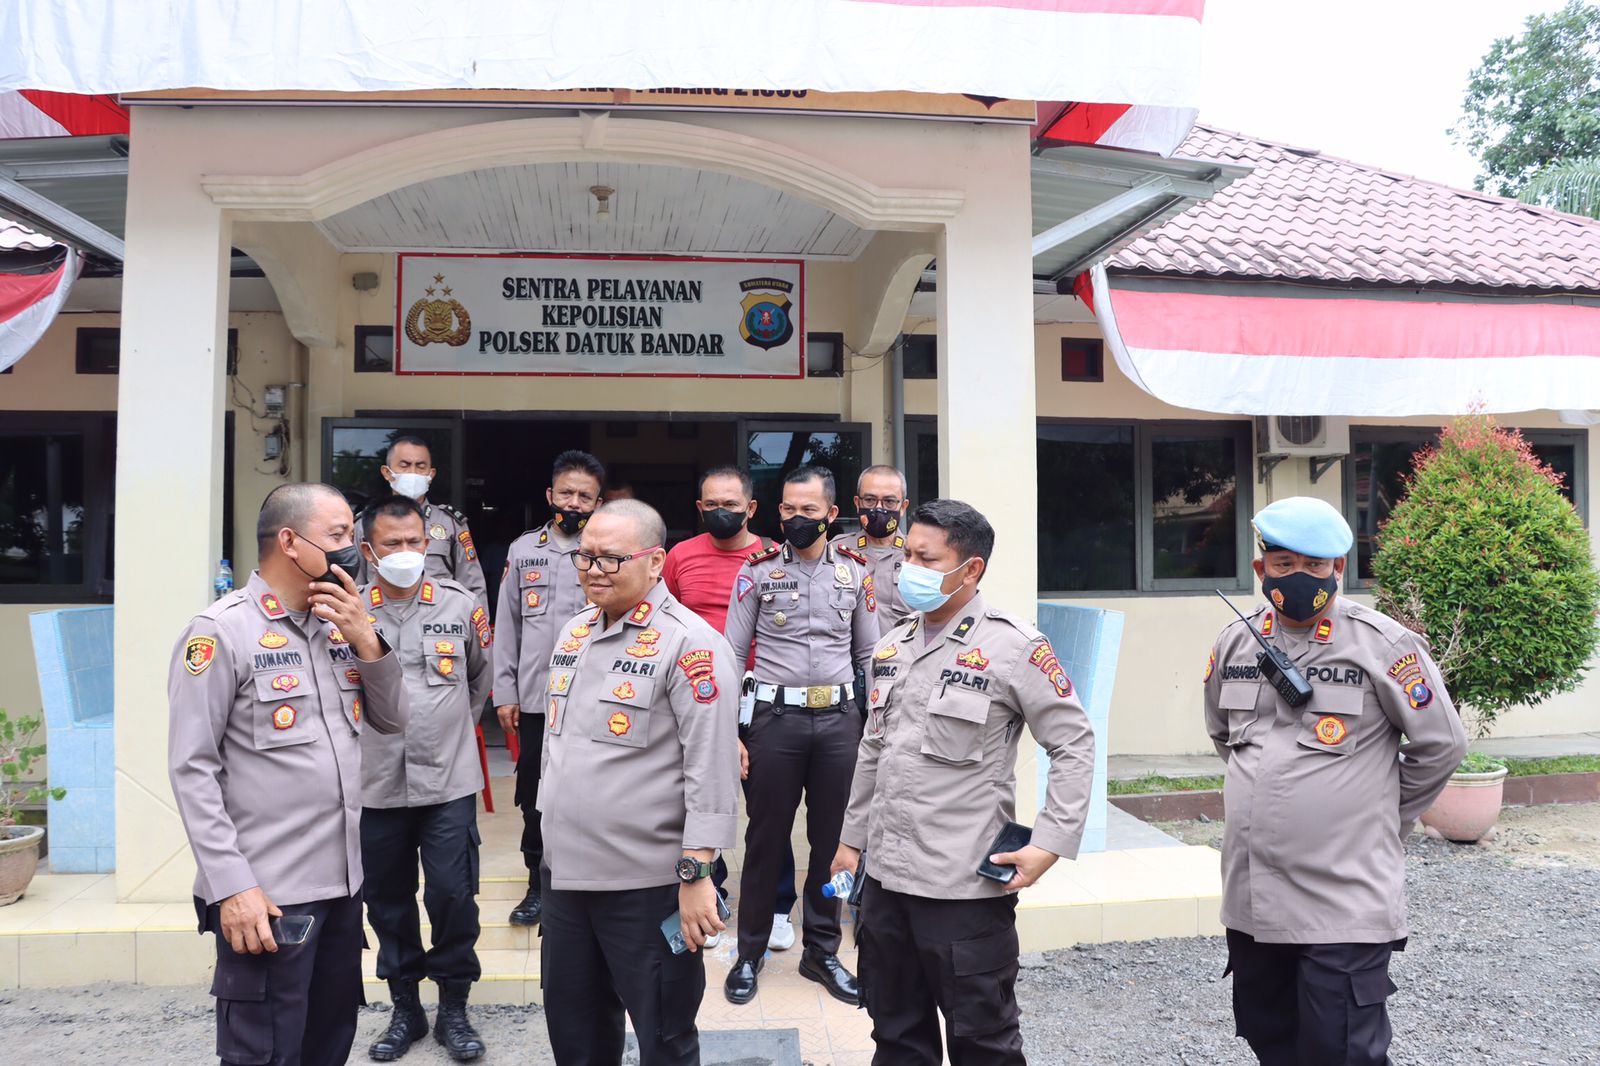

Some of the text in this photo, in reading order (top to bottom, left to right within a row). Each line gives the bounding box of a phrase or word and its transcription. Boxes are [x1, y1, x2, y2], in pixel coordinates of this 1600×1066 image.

[502, 277, 702, 301] SENTRA PELAYANAN
[541, 304, 663, 327] KEPOLISIAN
[478, 330, 725, 355] POLSEK DATUK BANDAR
[520, 558, 549, 568] J.SINAGA
[423, 623, 463, 634] POLRI
[254, 651, 303, 669] JUMANTO
[552, 654, 578, 667] YUSUF
[612, 660, 656, 676] POLRI
[940, 669, 990, 691] POLRI
[1306, 666, 1364, 684] POLRI
